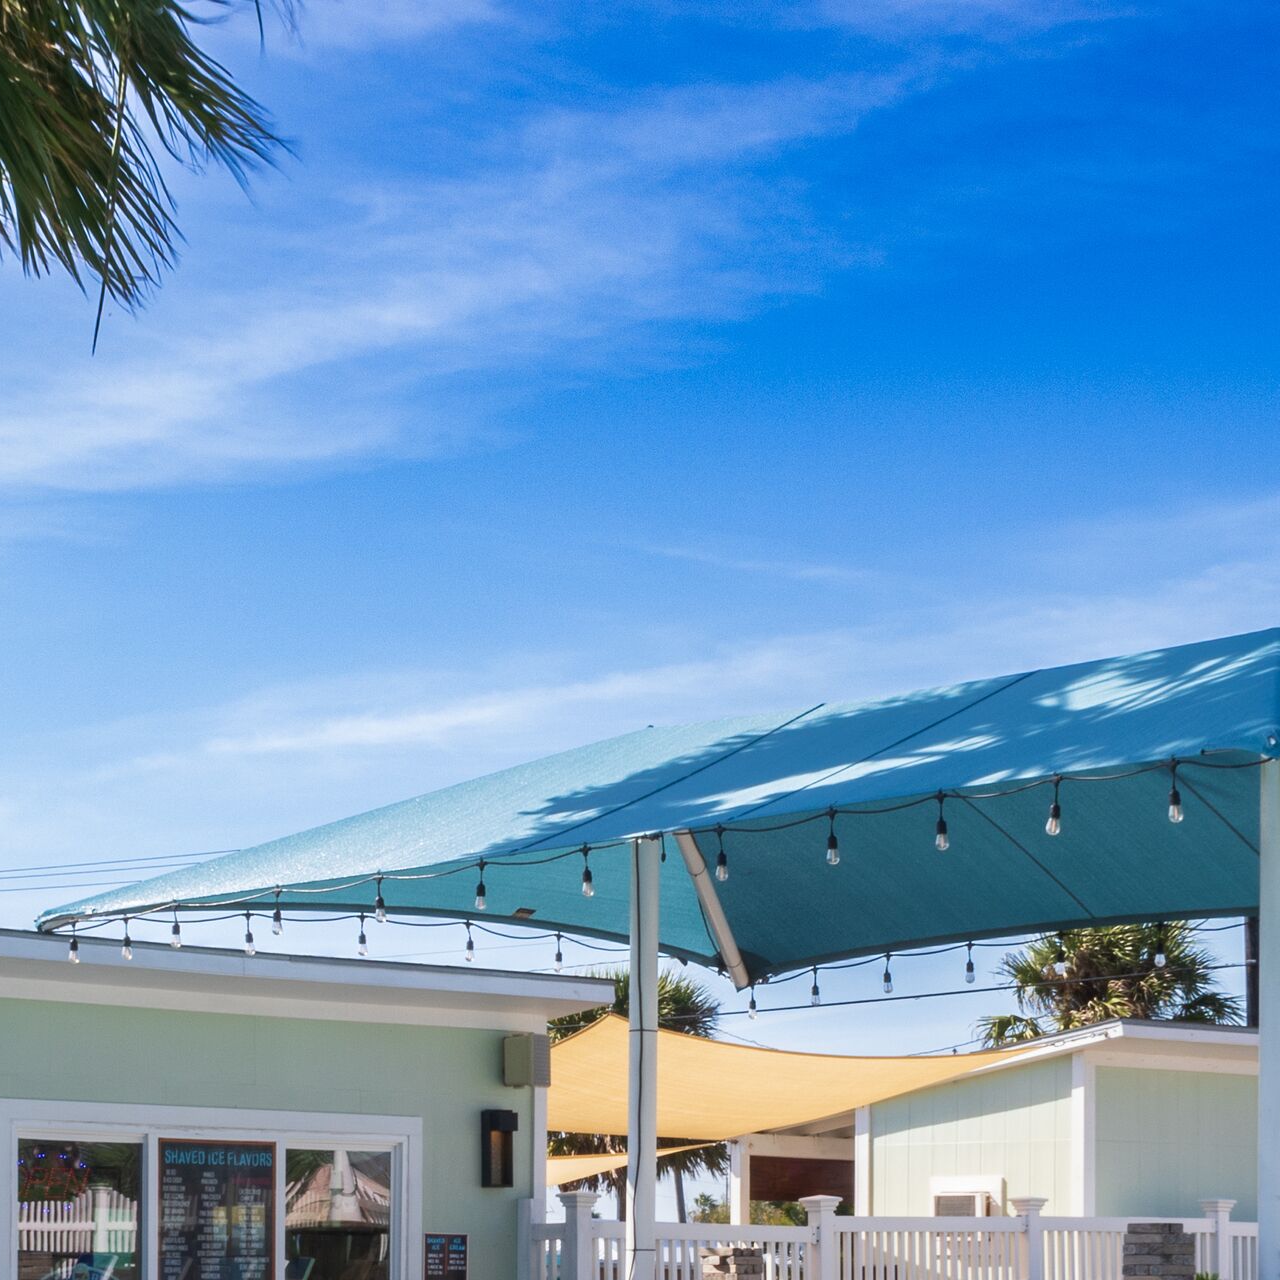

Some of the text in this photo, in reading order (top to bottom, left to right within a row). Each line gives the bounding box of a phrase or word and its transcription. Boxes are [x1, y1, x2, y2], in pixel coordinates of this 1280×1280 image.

[165, 1150, 273, 1167] SHAVED ICE FLAVORS
